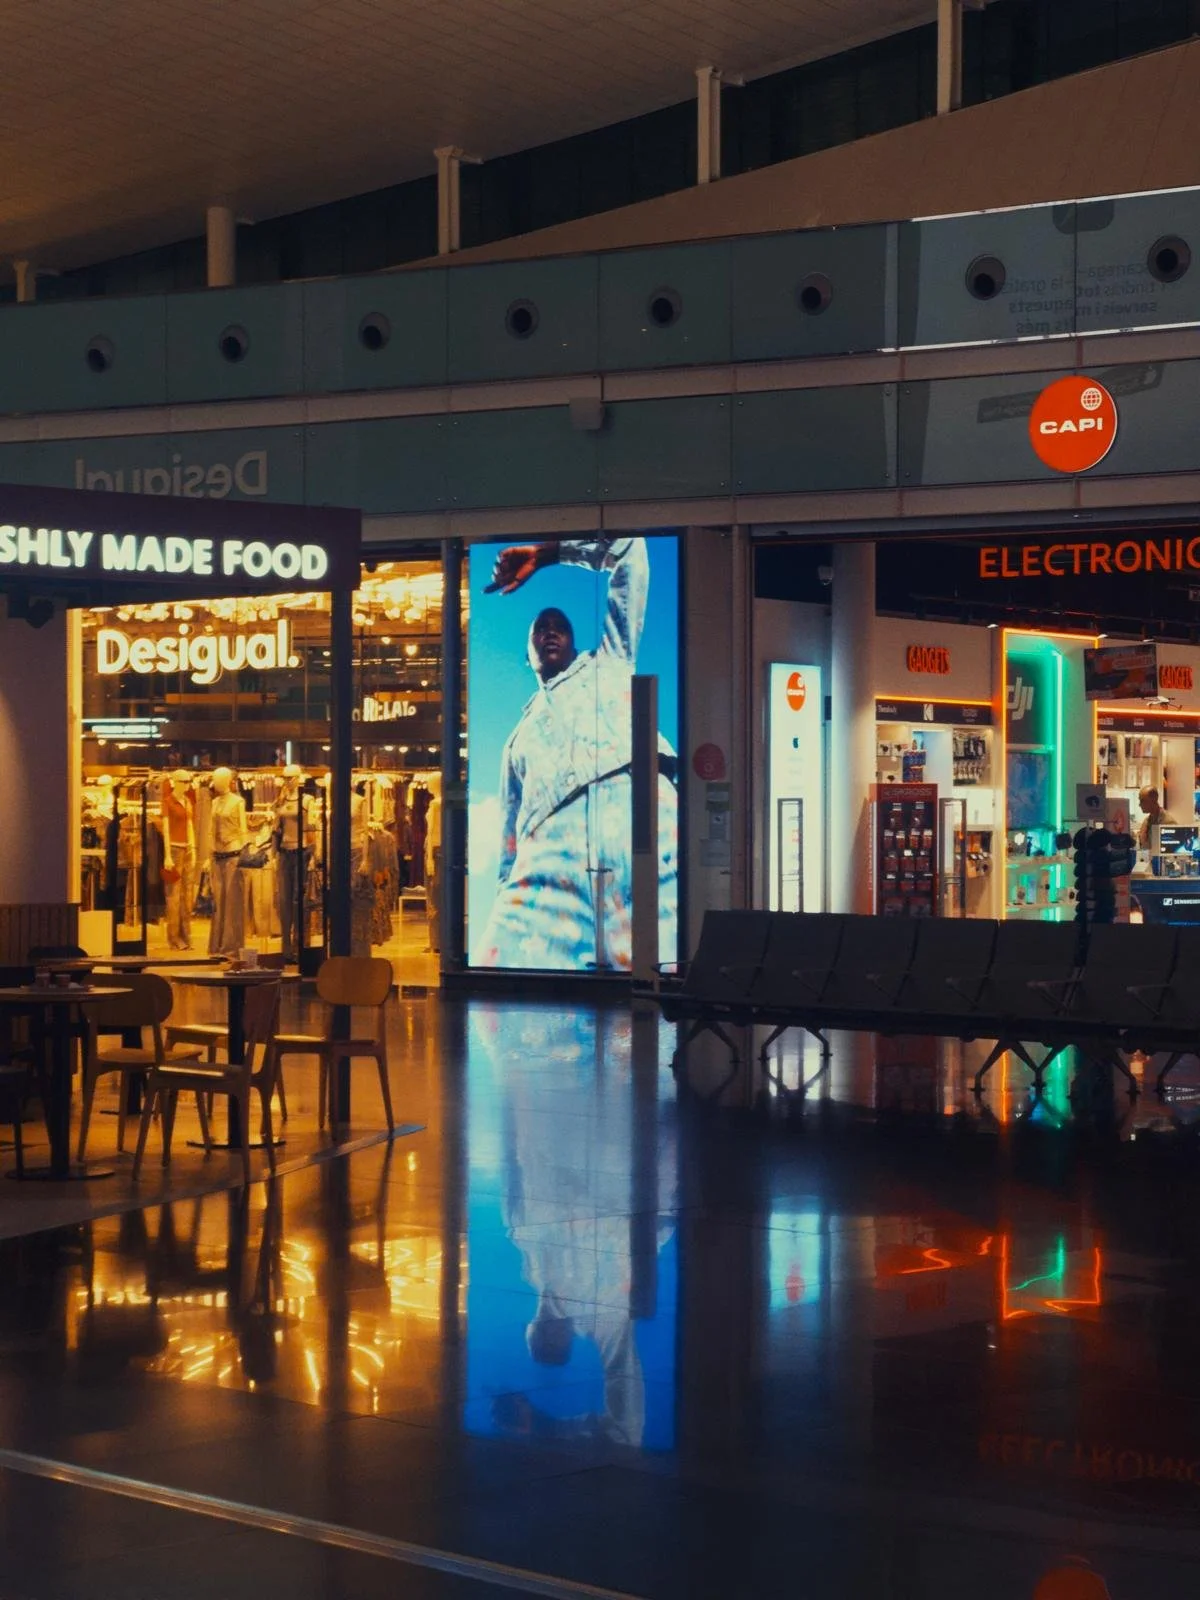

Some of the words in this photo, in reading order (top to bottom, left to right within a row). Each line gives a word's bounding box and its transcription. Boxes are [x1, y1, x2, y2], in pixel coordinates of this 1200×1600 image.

[1039, 417, 1103, 434] CAPI
[102, 533, 212, 575] MADE
[223, 540, 328, 580] FOOD
[979, 536, 1200, 578] ELECTRONIC
[907, 645, 950, 675] GADGETS
